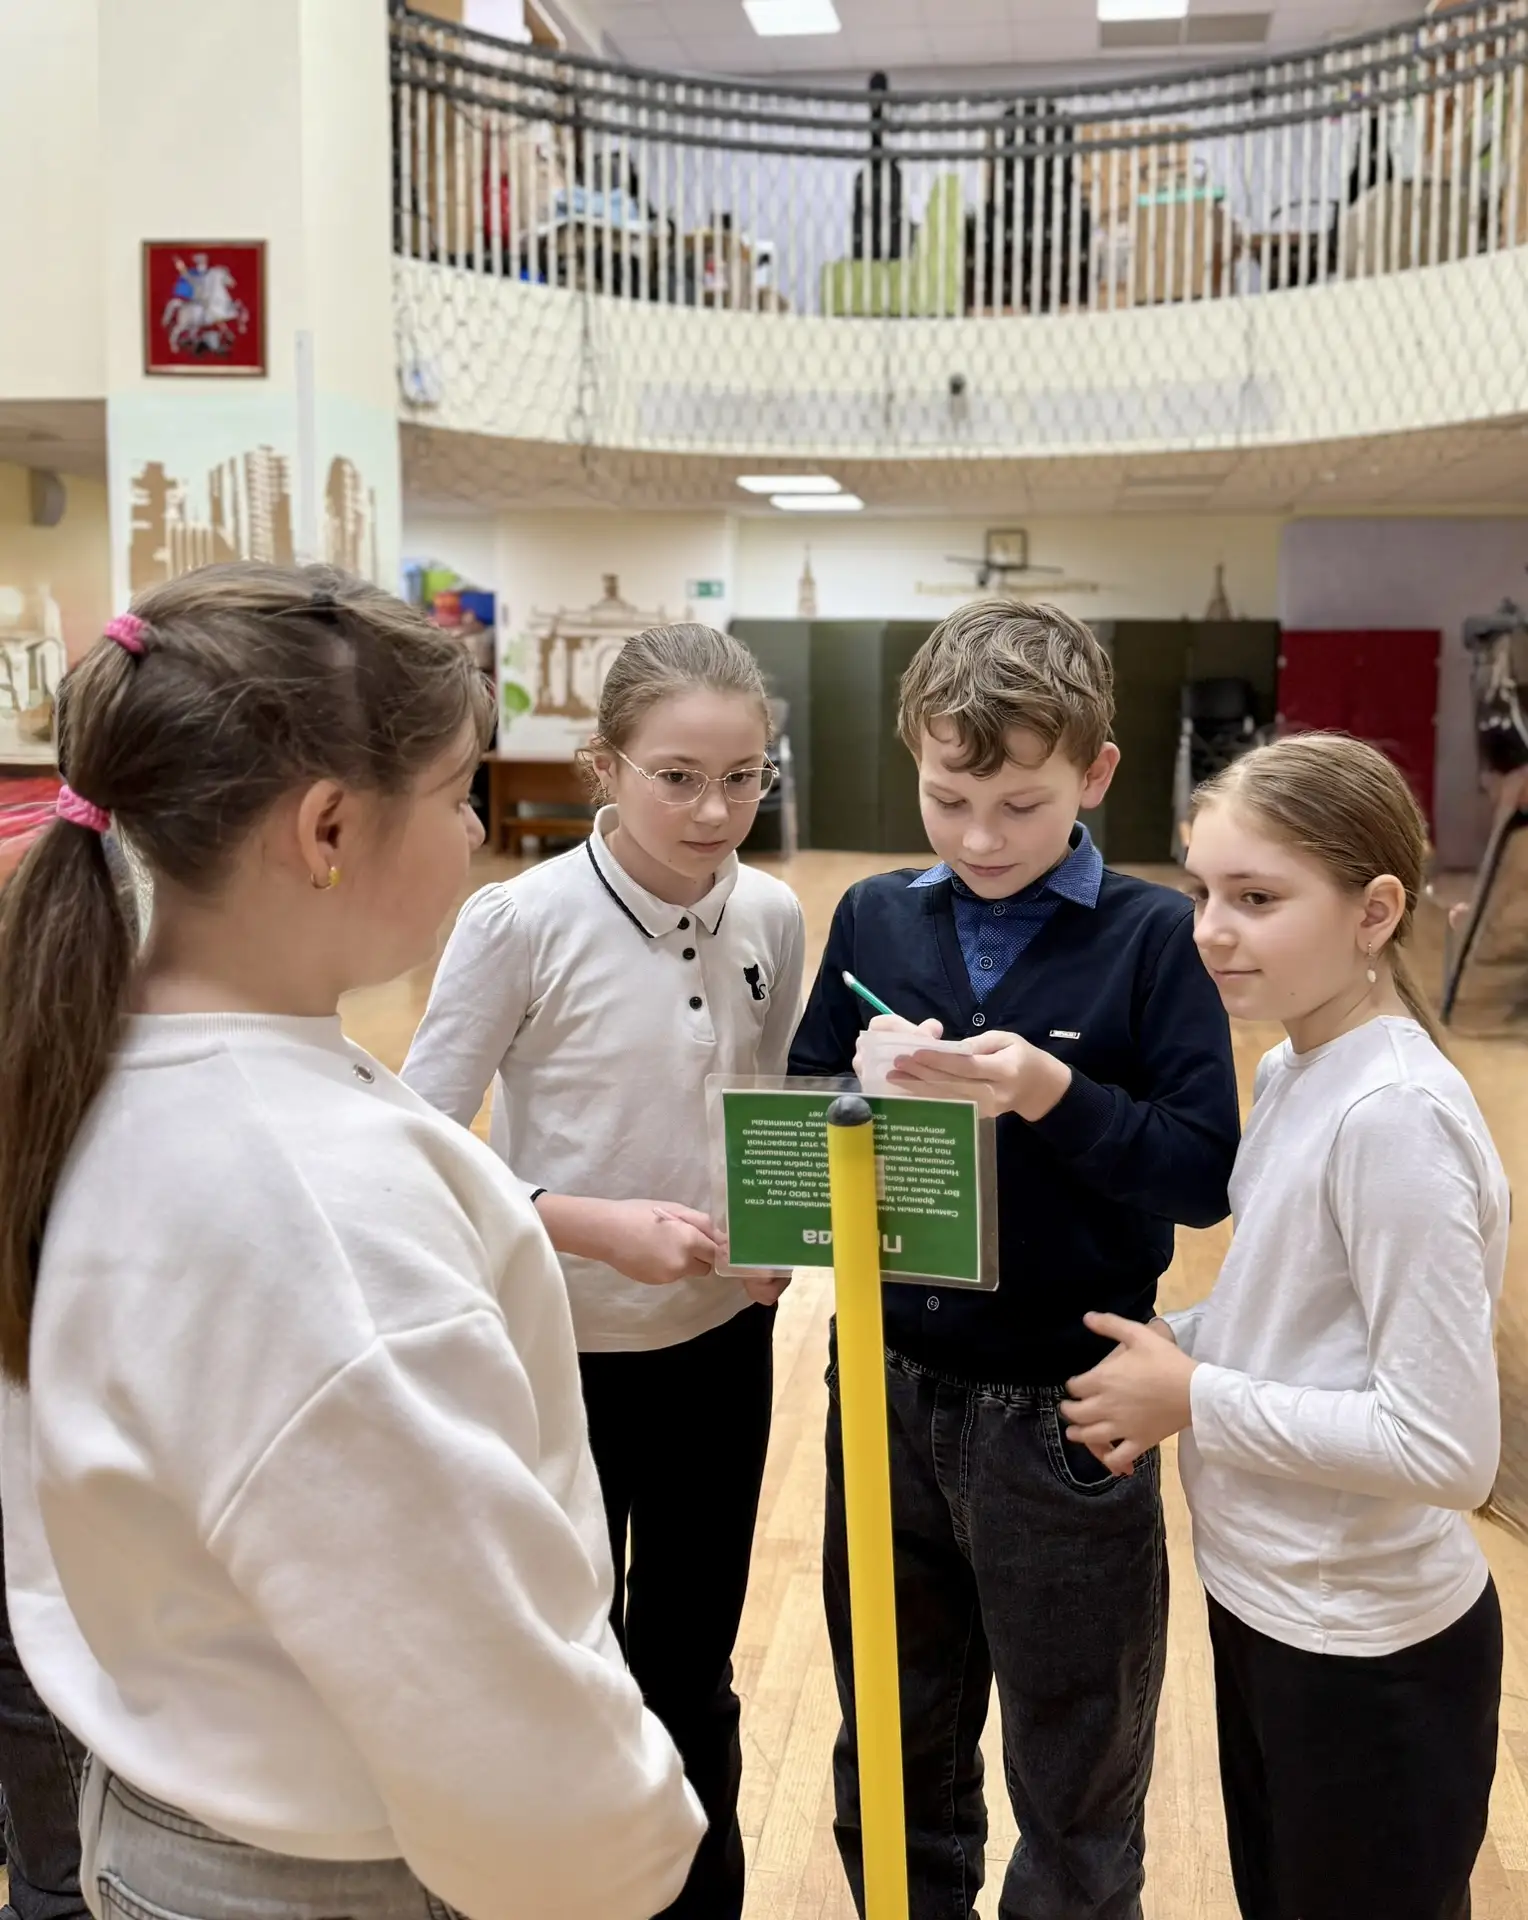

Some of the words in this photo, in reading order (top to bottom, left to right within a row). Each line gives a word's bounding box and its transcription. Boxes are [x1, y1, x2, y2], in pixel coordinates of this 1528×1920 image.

[751, 1119, 804, 1128] Олимпиады
[742, 1129, 797, 1137] минимально
[890, 1124, 946, 1135] допустимый
[747, 1139, 798, 1147] возрастной
[904, 1135, 922, 1143] уже
[924, 1137, 956, 1146] рекорд
[912, 1145, 933, 1154] руку
[934, 1148, 951, 1156] под
[784, 1159, 813, 1168] гребле
[914, 1157, 955, 1166] слишком
[797, 1170, 830, 1178] улевой
[898, 1166, 960, 1177] Нидерландов
[775, 1179, 797, 1187] было
[799, 1180, 817, 1188] ему
[919, 1177, 945, 1185] точно
[767, 1188, 787, 1196] году
[788, 1190, 811, 1198] 1900
[910, 1186, 941, 1195] только
[943, 1189, 960, 1198] Вот
[766, 1198, 782, 1206] игр
[897, 1206, 924, 1215] юным
[925, 1208, 959, 1218] Самым
[802, 1228, 903, 1253] Пда
